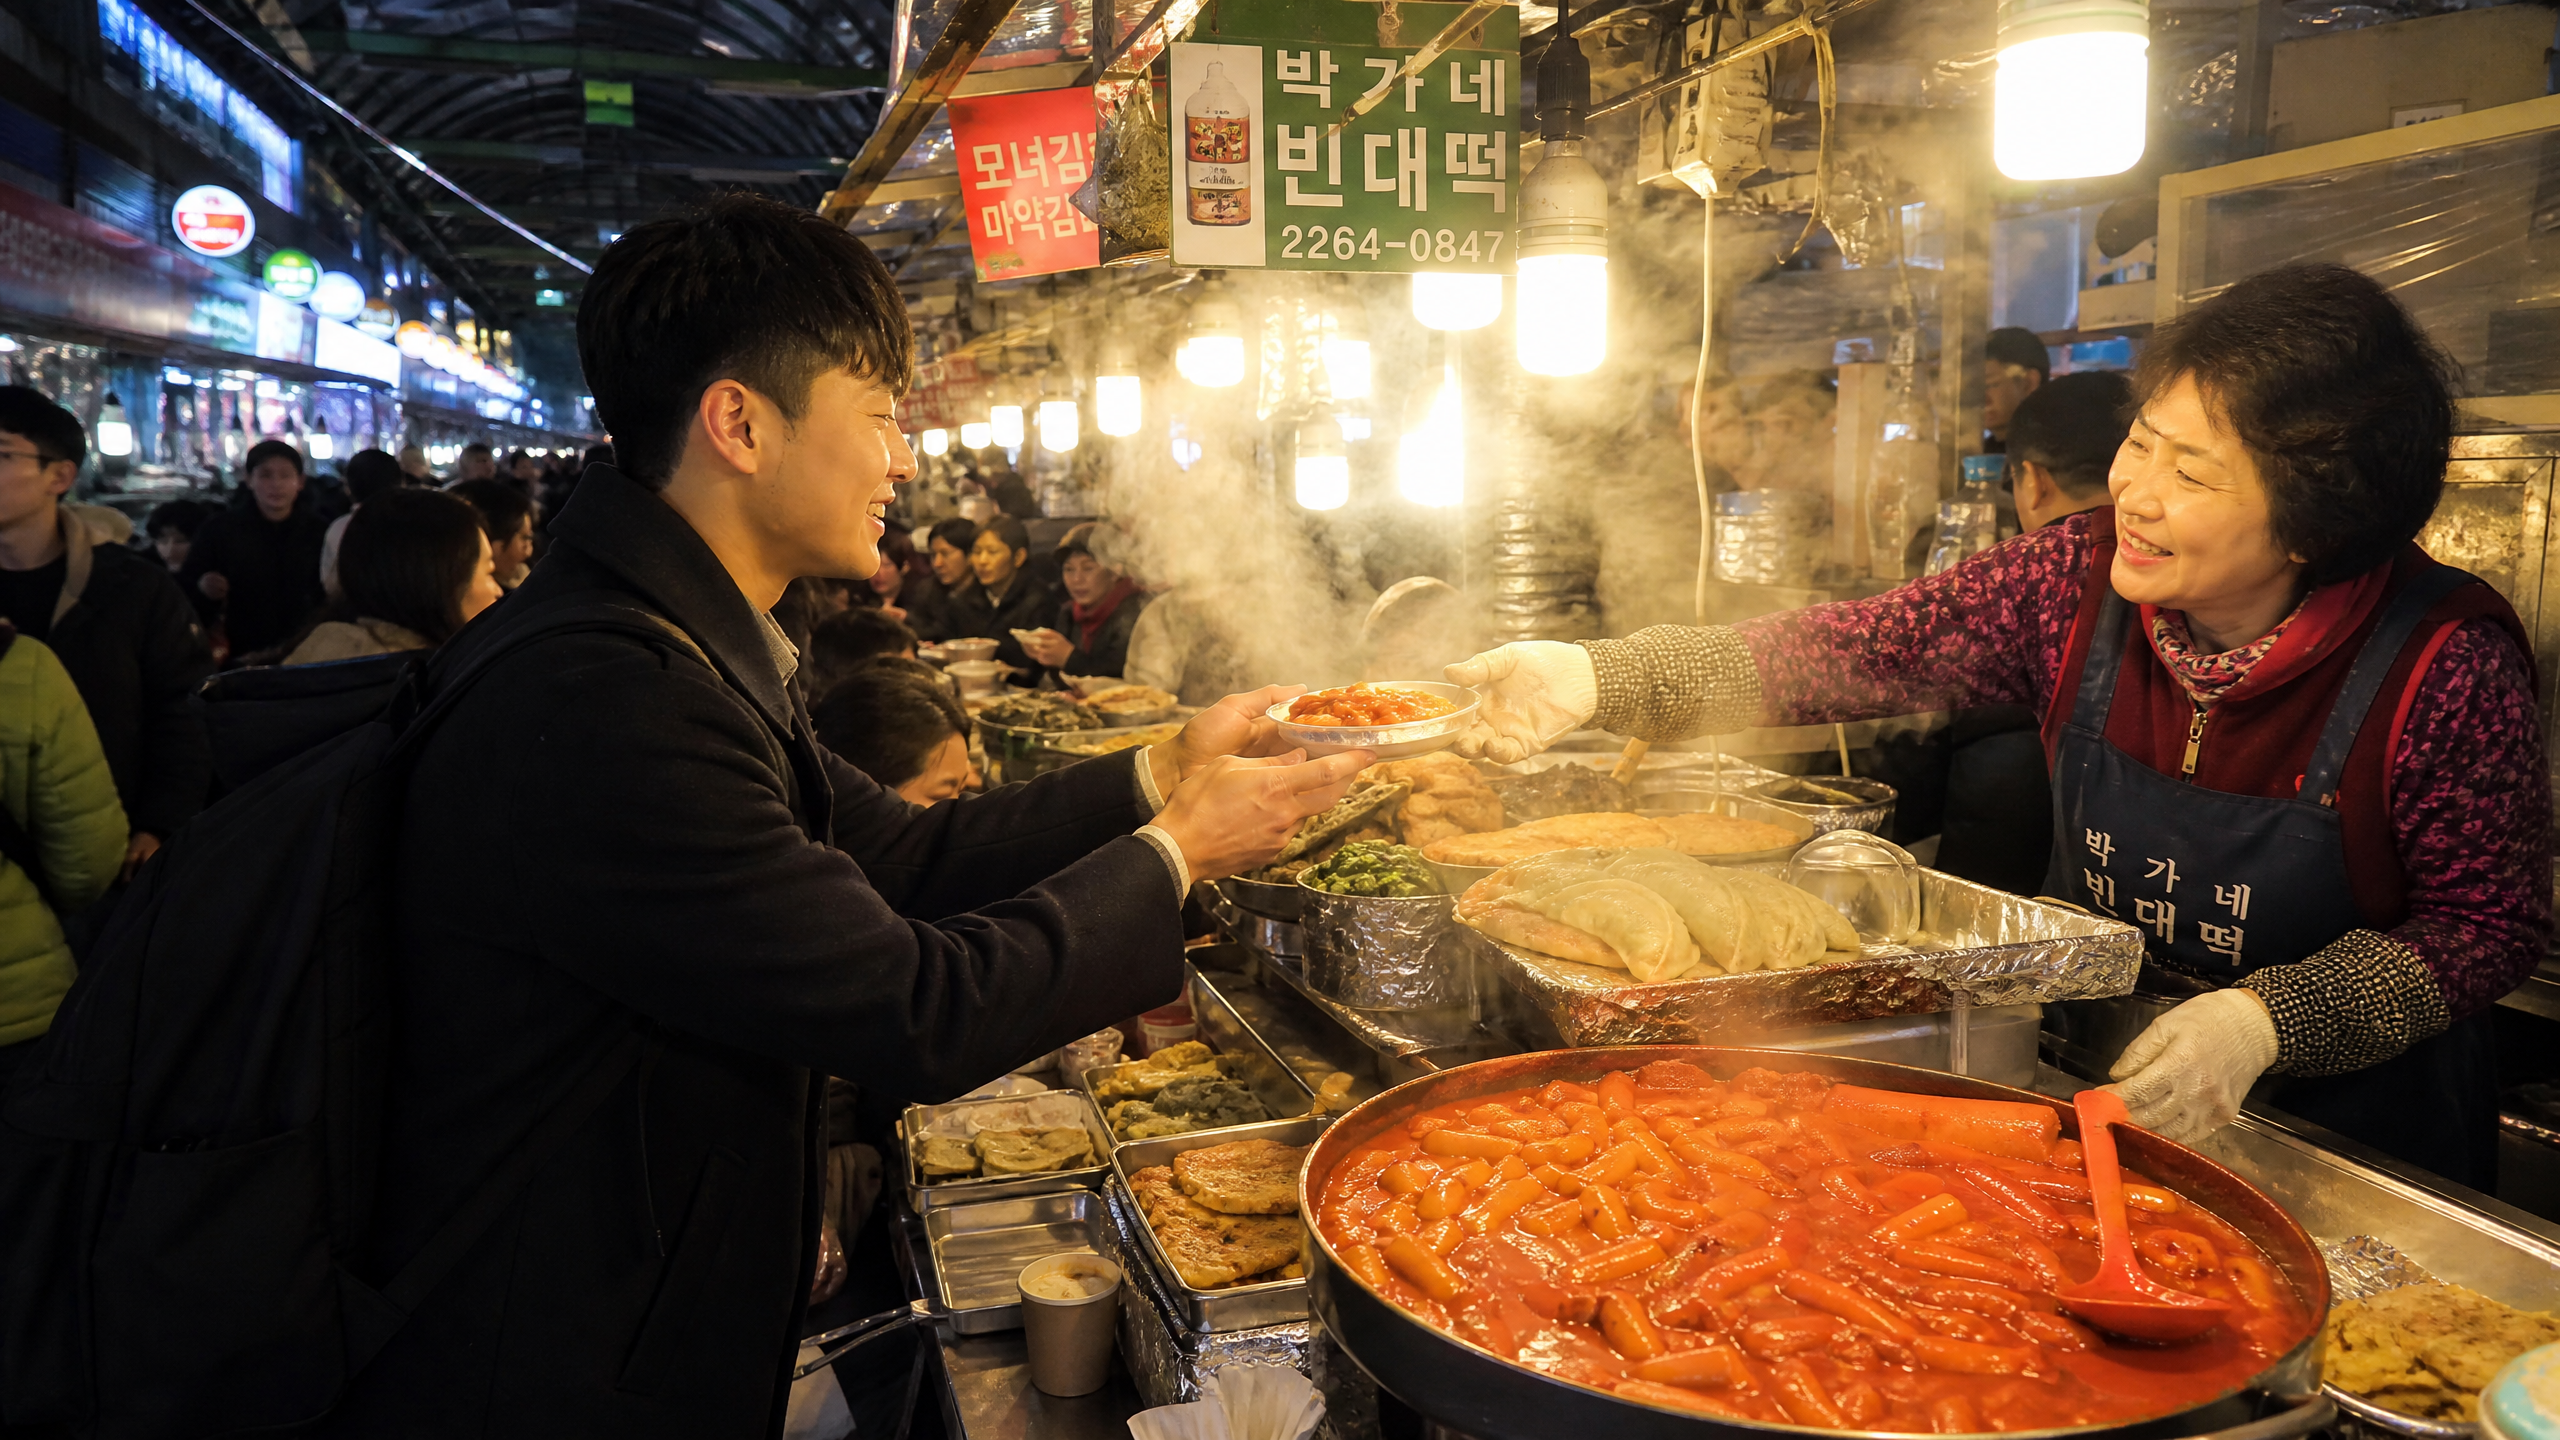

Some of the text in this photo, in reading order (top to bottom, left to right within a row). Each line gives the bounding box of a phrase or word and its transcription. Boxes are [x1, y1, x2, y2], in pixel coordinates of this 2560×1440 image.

[1276, 50, 1506, 117] 박가네
[973, 132, 1096, 190] 모녀김
[1277, 124, 1506, 213] 빈대떡
[1281, 225, 1504, 263] 2264-0847
[2086, 828, 2251, 920] 박가네
[2084, 868, 2244, 966] 빈대떡
